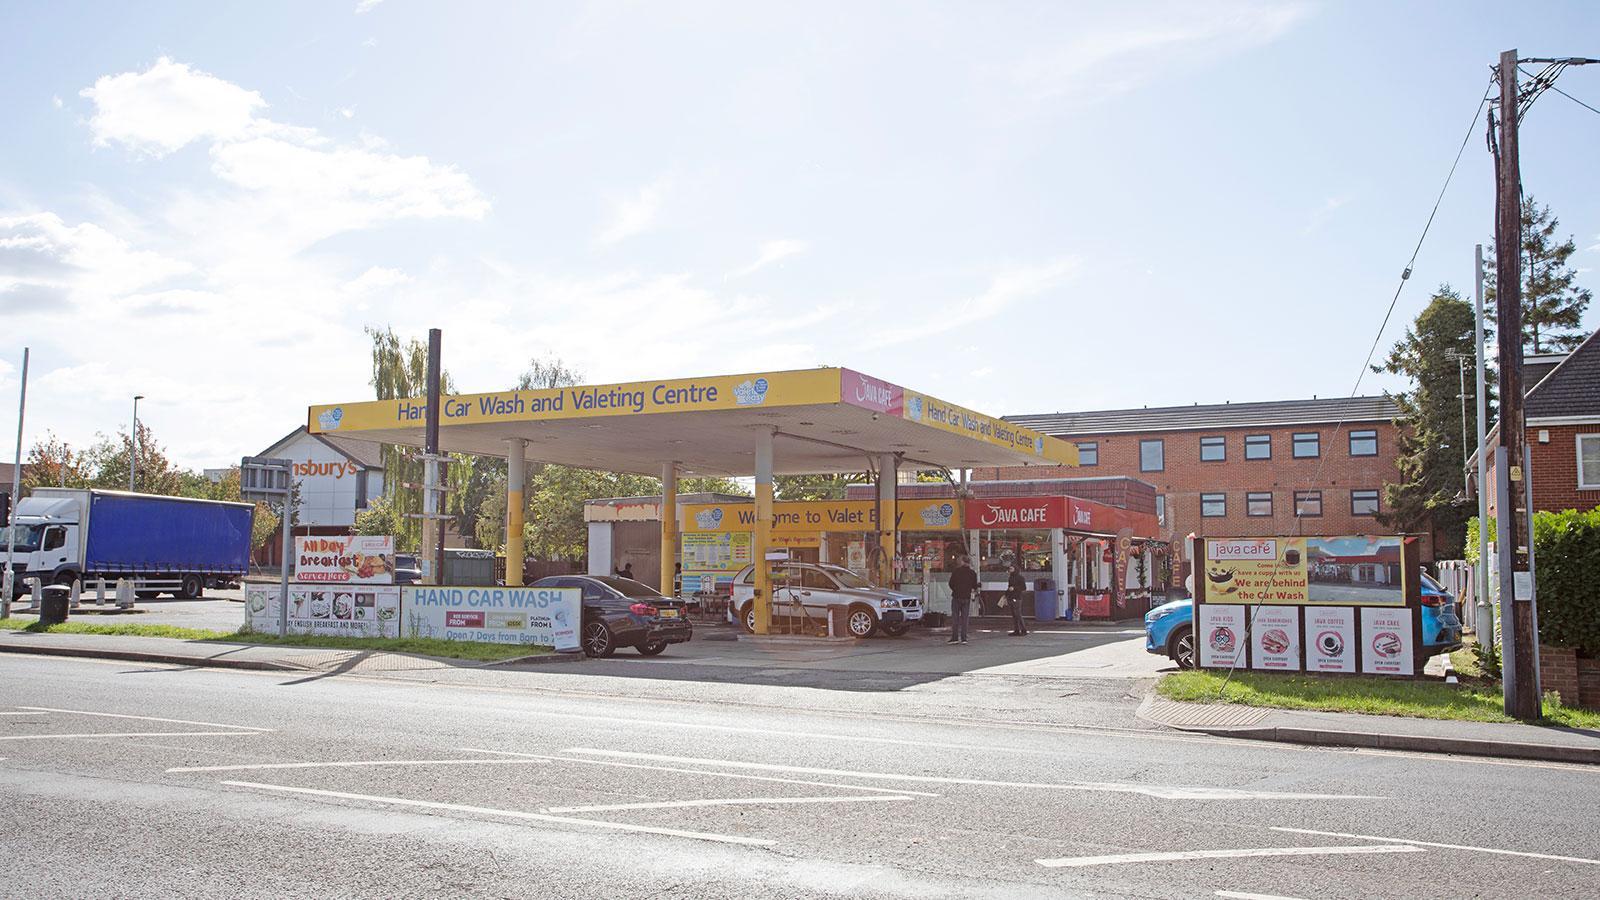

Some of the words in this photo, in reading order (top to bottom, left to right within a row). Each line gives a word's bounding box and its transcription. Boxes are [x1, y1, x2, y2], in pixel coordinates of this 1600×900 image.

[856, 375, 878, 403] JAVA
[398, 402, 427, 421] Han
[444, 400, 472, 418] Car
[480, 394, 525, 416] Wash
[532, 391, 563, 412] and
[572, 387, 645, 413] Valeting
[652, 384, 718, 406] Centre
[927, 402, 946, 423] Hand
[948, 408, 960, 426] Car
[961, 412, 979, 432] Wash
[980, 420, 992, 436] and
[993, 423, 1014, 448] Valeting
[1015, 430, 1033, 448] Centre
[292, 458, 358, 480] nsbury's
[806, 510, 821, 524] to
[828, 508, 864, 524] Valet
[981, 504, 1018, 525] JAVA
[1020, 504, 1048, 522] CAFÉ
[304, 540, 318, 552] All
[320, 538, 344, 556] Day
[1216, 544, 1240, 557] java
[300, 554, 359, 568] Breakfast
[415, 589, 462, 606] HAND
[468, 590, 504, 607] CAR
[508, 590, 562, 608] WASH
[446, 631, 466, 640] Open
[477, 632, 496, 642] Days
[498, 632, 517, 641] from
[520, 633, 538, 642] 8am
[541, 634, 548, 642] to
